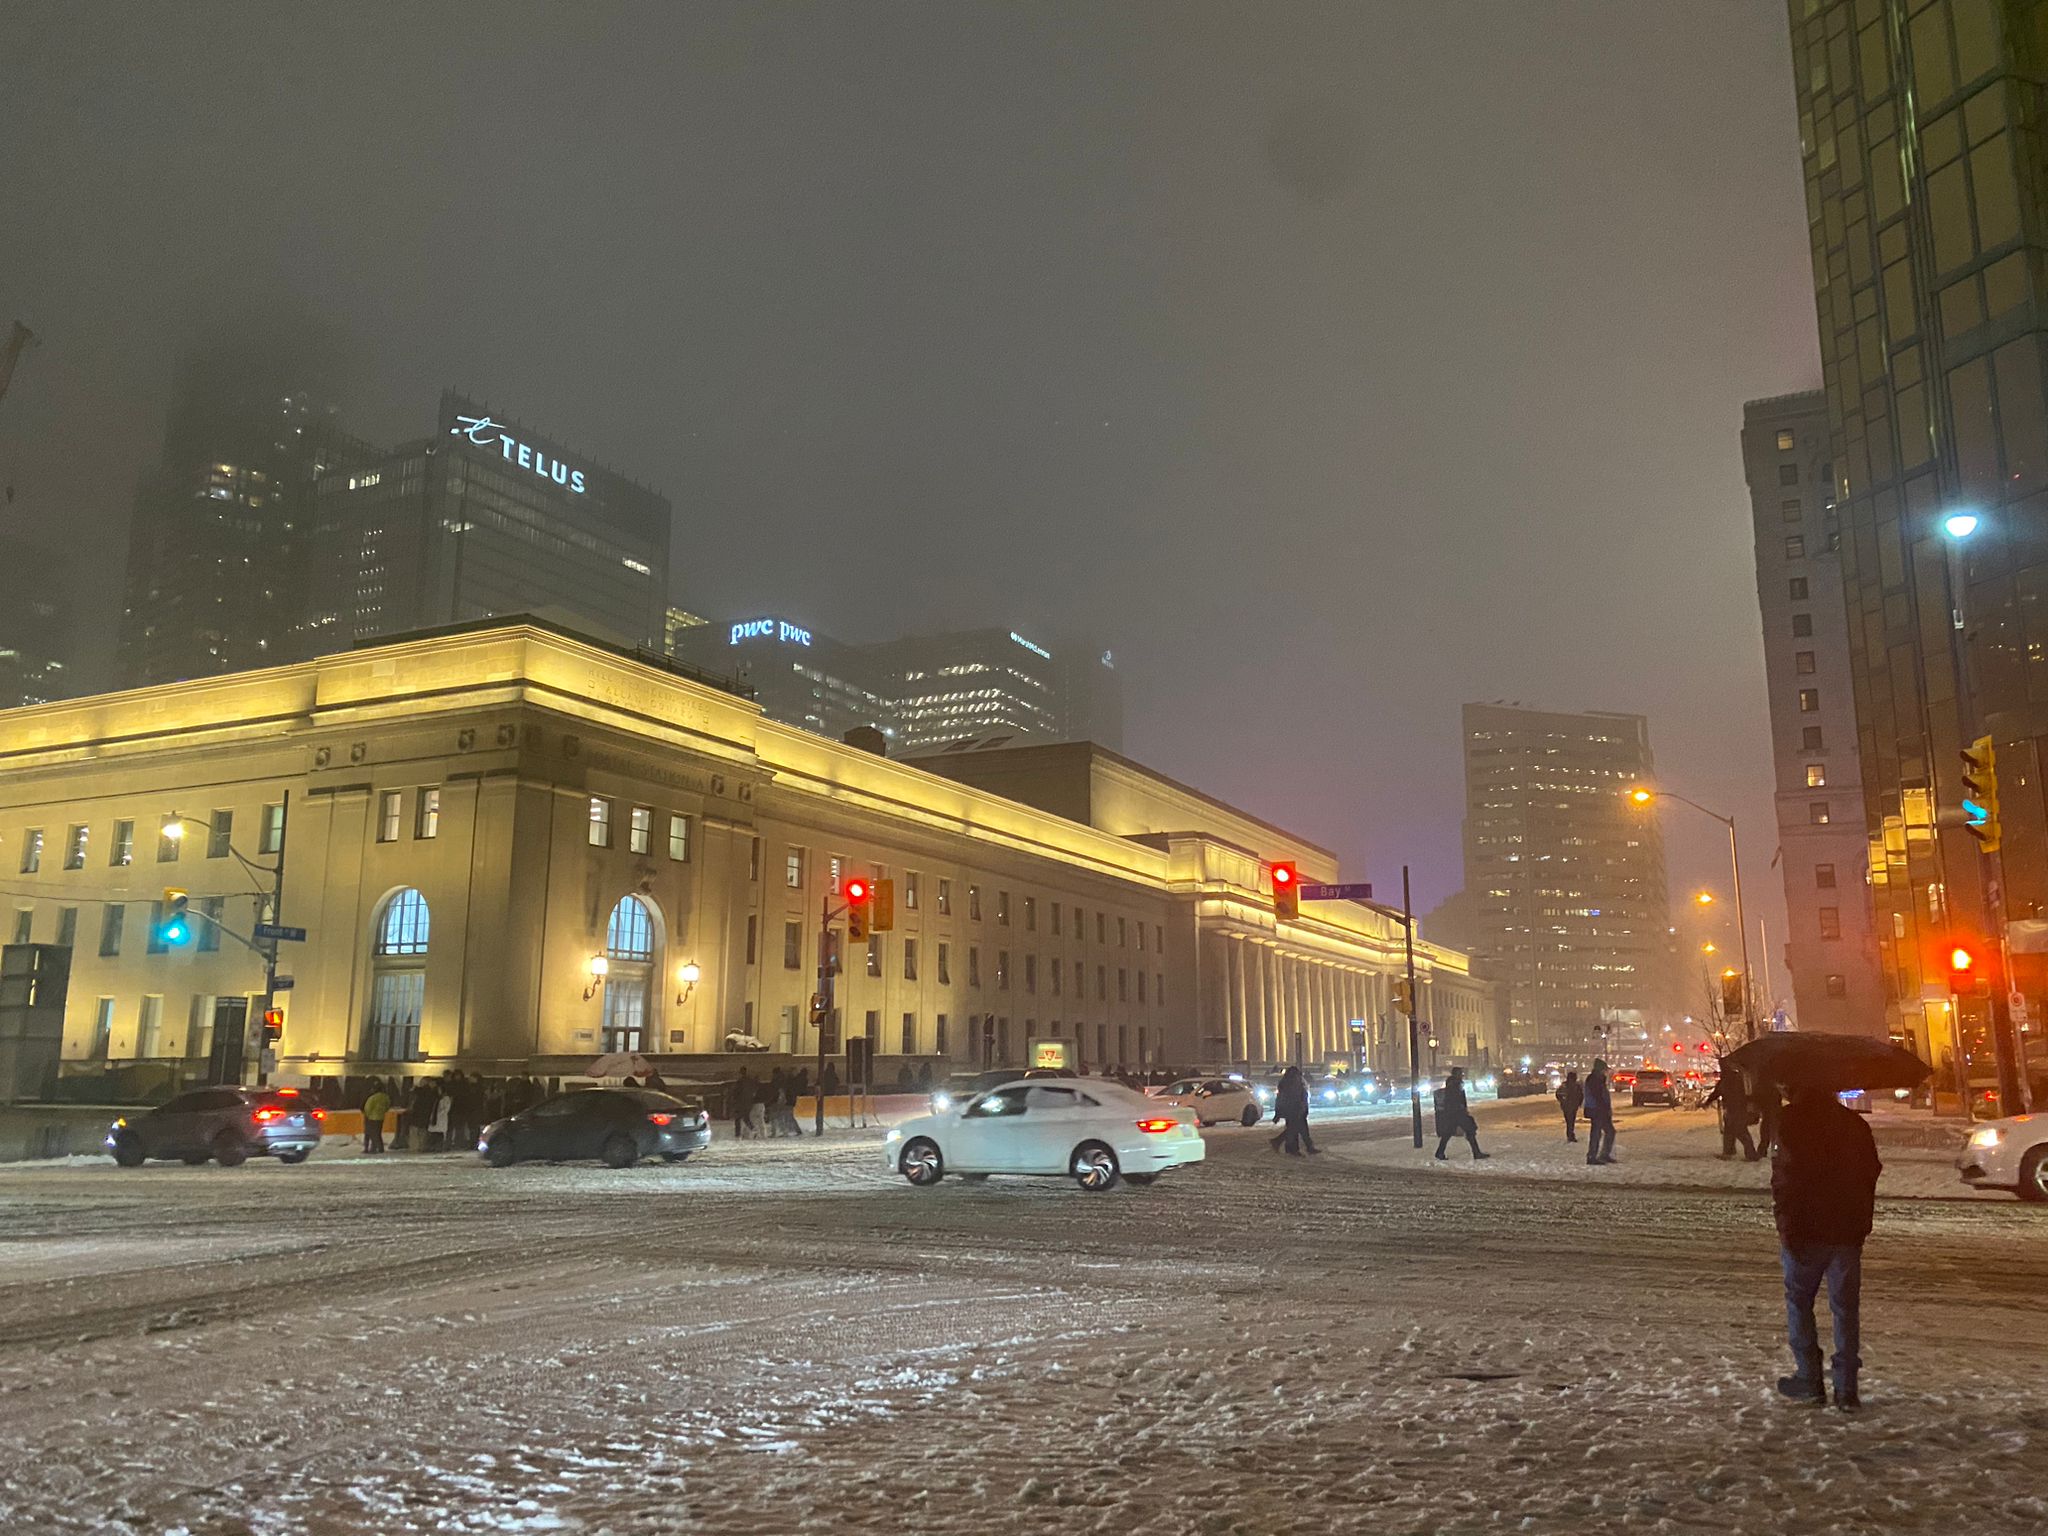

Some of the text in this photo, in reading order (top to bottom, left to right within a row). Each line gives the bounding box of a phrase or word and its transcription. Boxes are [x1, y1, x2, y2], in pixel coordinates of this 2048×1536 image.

[499, 434, 585, 493] TELUS
[730, 619, 773, 645] pwc
[779, 621, 811, 646] pwc
[1320, 886, 1341, 898] Bay
